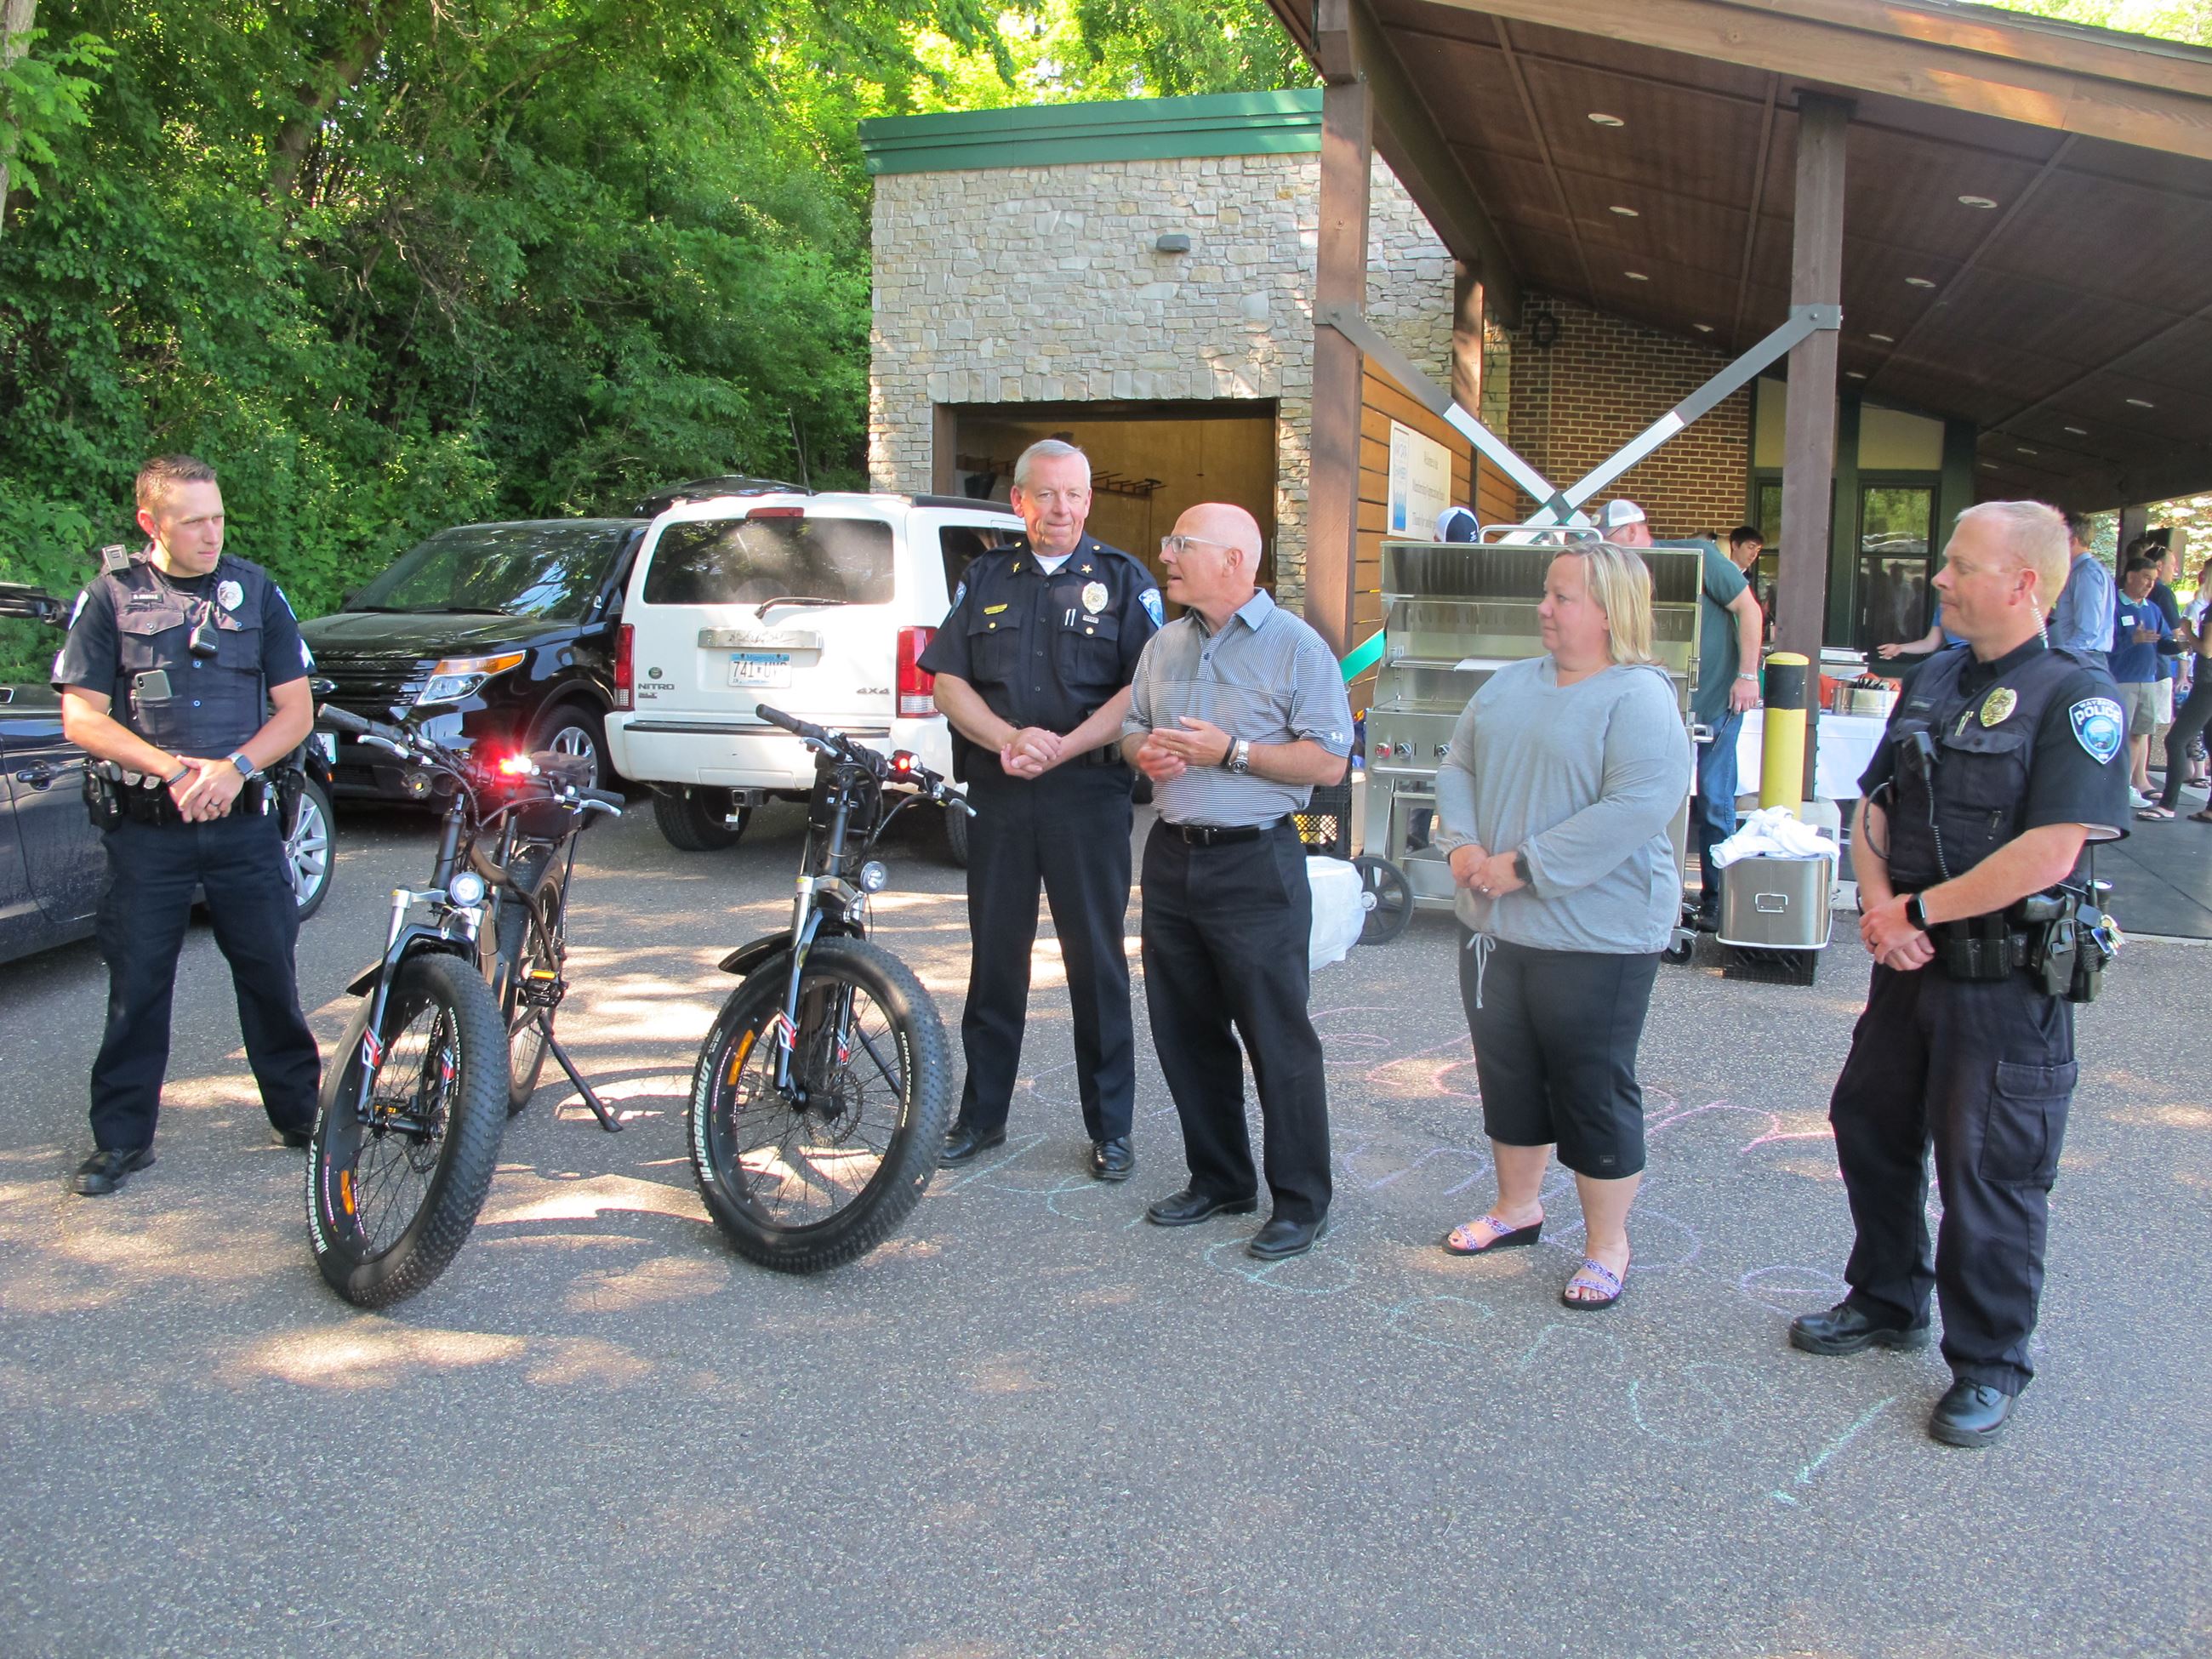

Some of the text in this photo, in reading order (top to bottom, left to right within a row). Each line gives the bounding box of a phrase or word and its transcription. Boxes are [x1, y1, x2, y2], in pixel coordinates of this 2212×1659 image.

[733, 661, 755, 678] 741
[2074, 705, 2120, 725] POLICE
[693, 1056, 712, 1167] JUGGERNAUT
[307, 1140, 322, 1242] JUGGERNAUT
